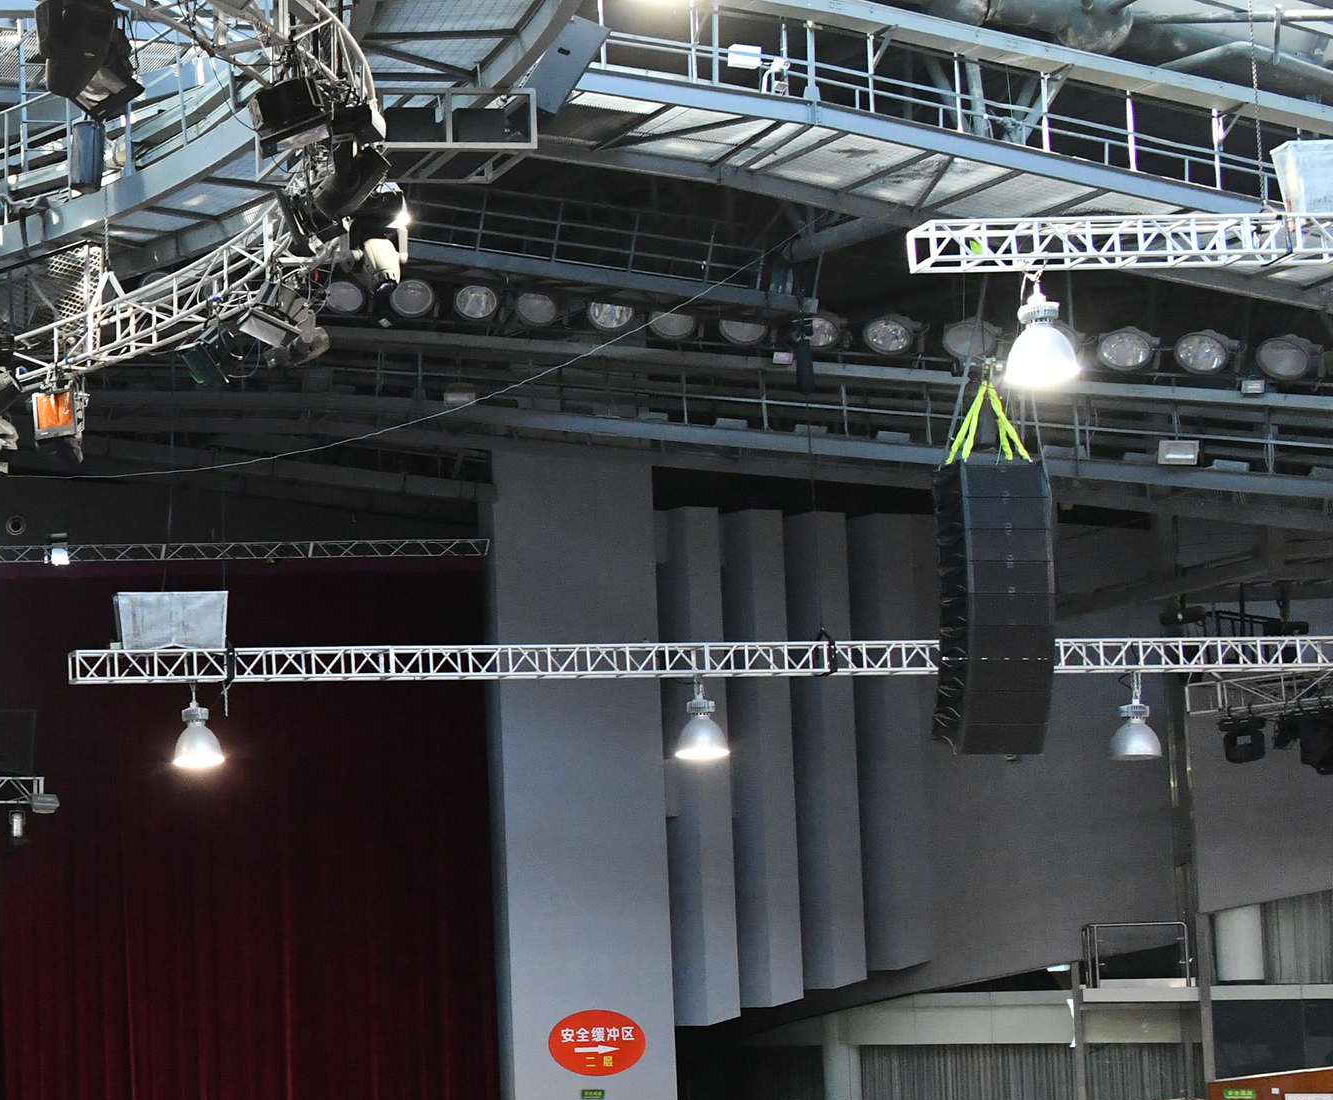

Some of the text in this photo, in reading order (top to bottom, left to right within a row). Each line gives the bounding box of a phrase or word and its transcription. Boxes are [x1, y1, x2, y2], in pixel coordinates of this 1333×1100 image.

[560, 1027, 635, 1043] 安全缓冲区
